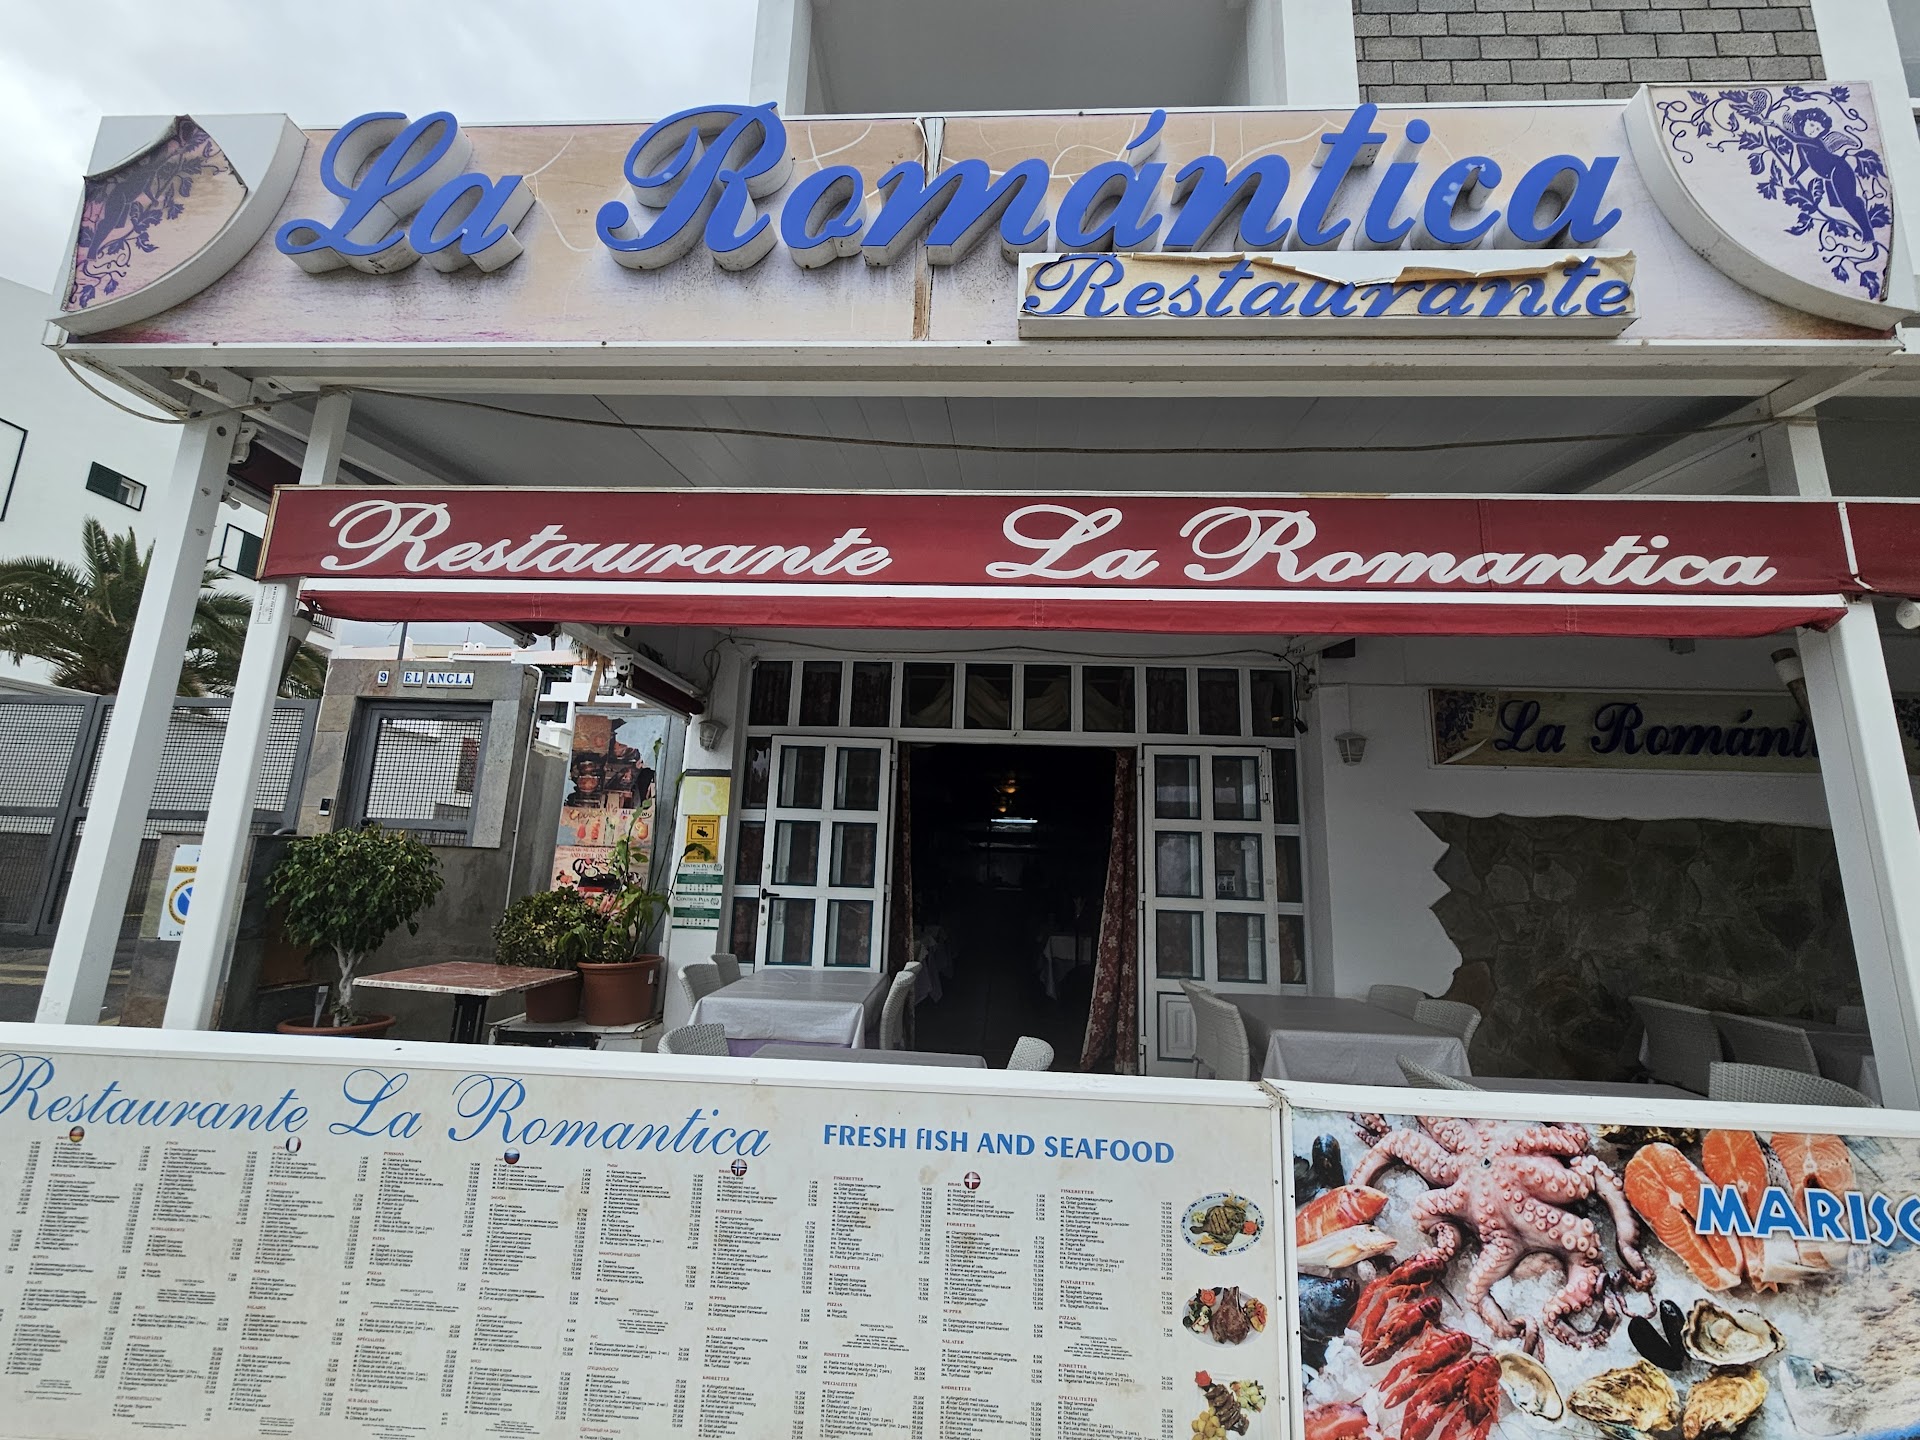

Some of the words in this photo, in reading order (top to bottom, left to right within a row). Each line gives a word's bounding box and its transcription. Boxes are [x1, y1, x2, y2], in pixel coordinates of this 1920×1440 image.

[275, 111, 523, 257] La
[596, 101, 1622, 252] Romántica
[1024, 253, 1634, 318] Restaurante
[320, 499, 893, 576] Restaurante
[985, 503, 1160, 580] La
[1177, 505, 1778, 587] Romantica
[380, 672, 387, 682] 9
[405, 672, 421, 683] EL
[428, 672, 472, 684] ANCLA
[1493, 700, 1566, 754] La
[0, 1053, 308, 1133] Restaurante
[328, 1068, 422, 1138] La
[448, 1073, 771, 1157] Romantica
[824, 1124, 907, 1149] FRESH
[976, 1132, 1035, 1156] AND
[1044, 1136, 1175, 1164] SEAFOOD
